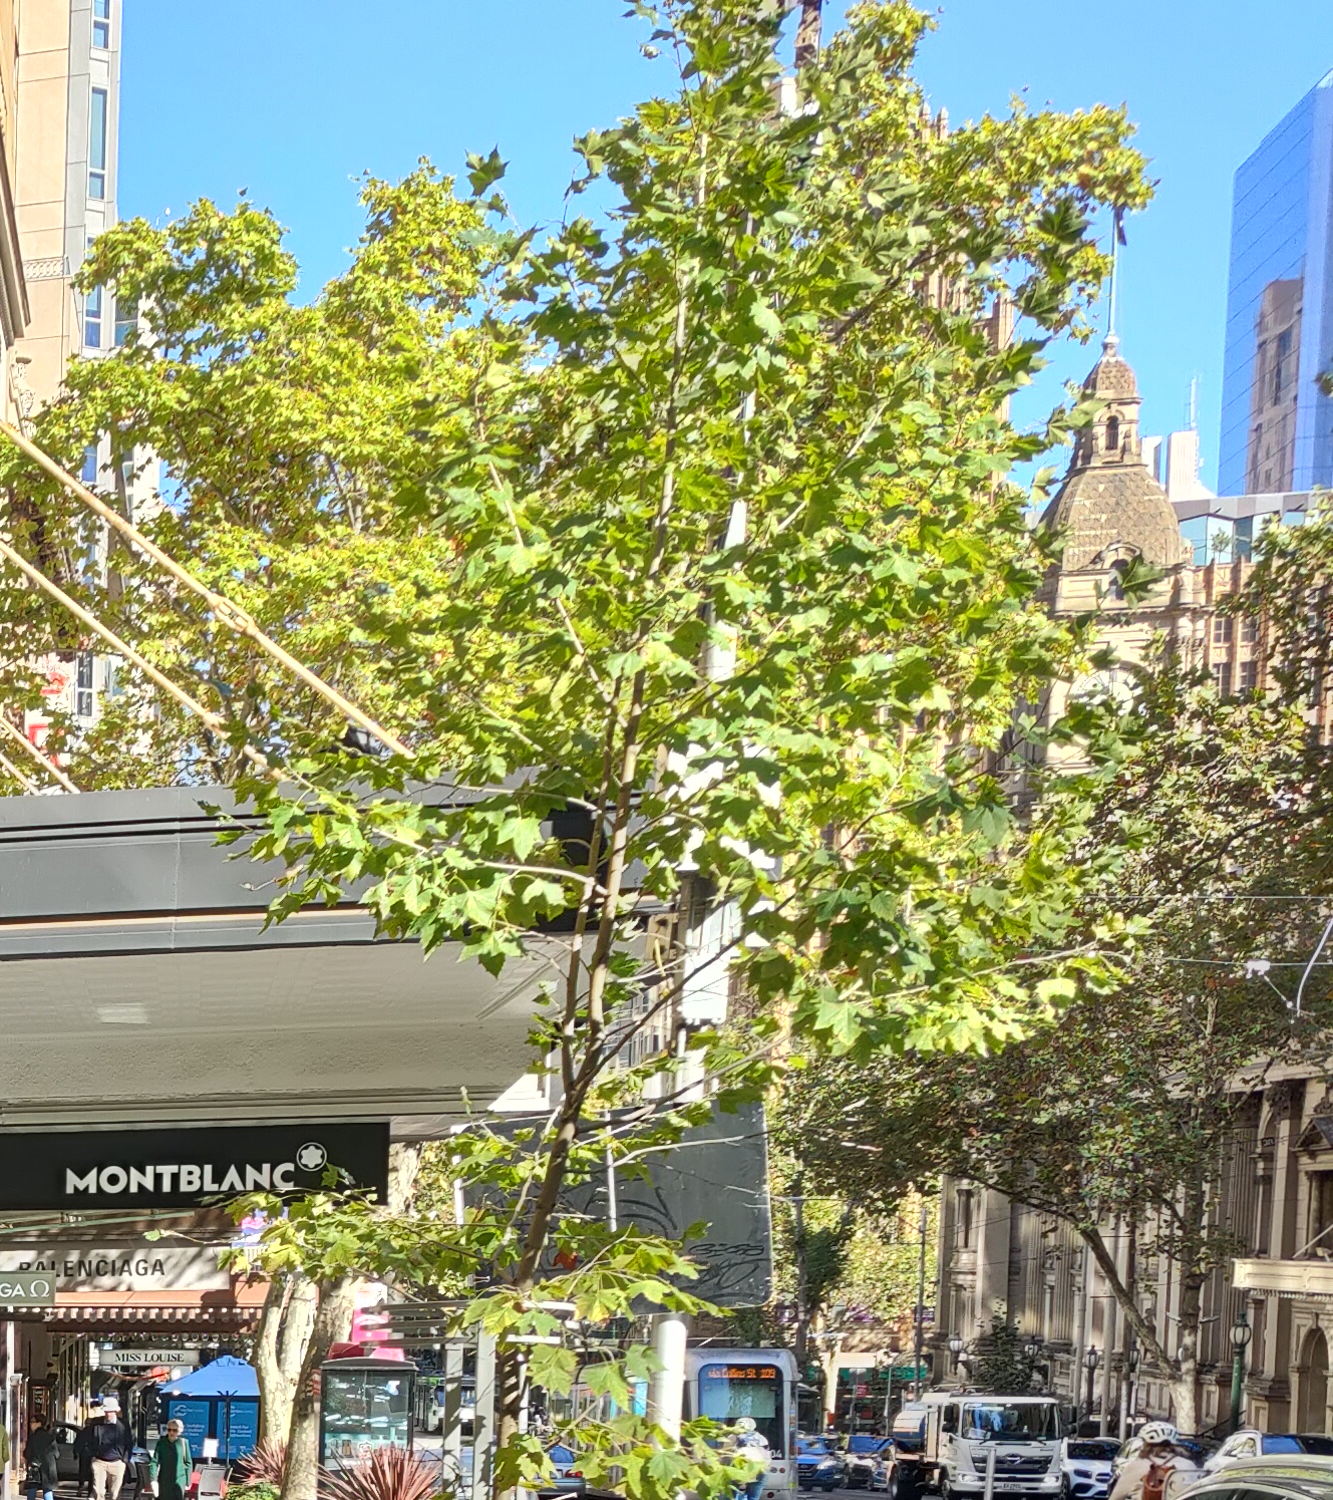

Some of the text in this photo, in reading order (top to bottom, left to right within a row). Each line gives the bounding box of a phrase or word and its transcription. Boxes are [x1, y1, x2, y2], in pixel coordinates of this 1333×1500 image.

[66, 1162, 295, 1194] MONTBLANC
[115, 1353, 185, 1362] MISS LOUISE
